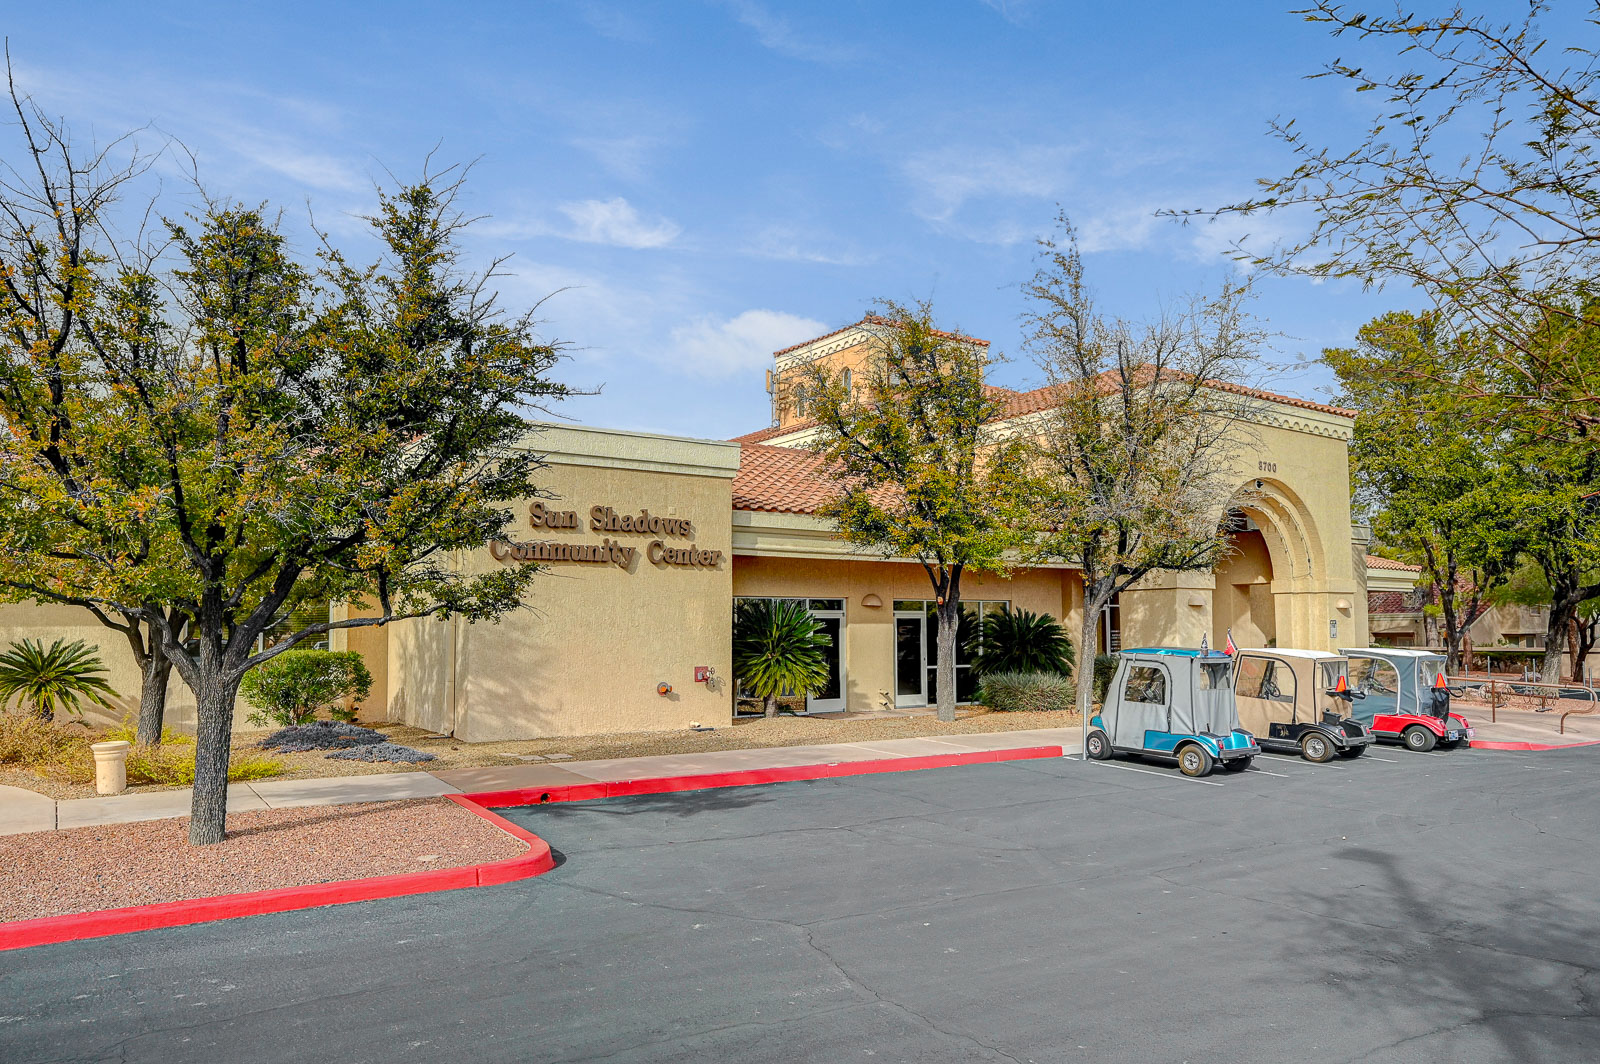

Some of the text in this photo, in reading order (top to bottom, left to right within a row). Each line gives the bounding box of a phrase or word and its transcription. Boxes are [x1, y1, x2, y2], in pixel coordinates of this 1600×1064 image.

[529, 501, 692, 536] Sun Shadows
[490, 538, 722, 567] Community Center
